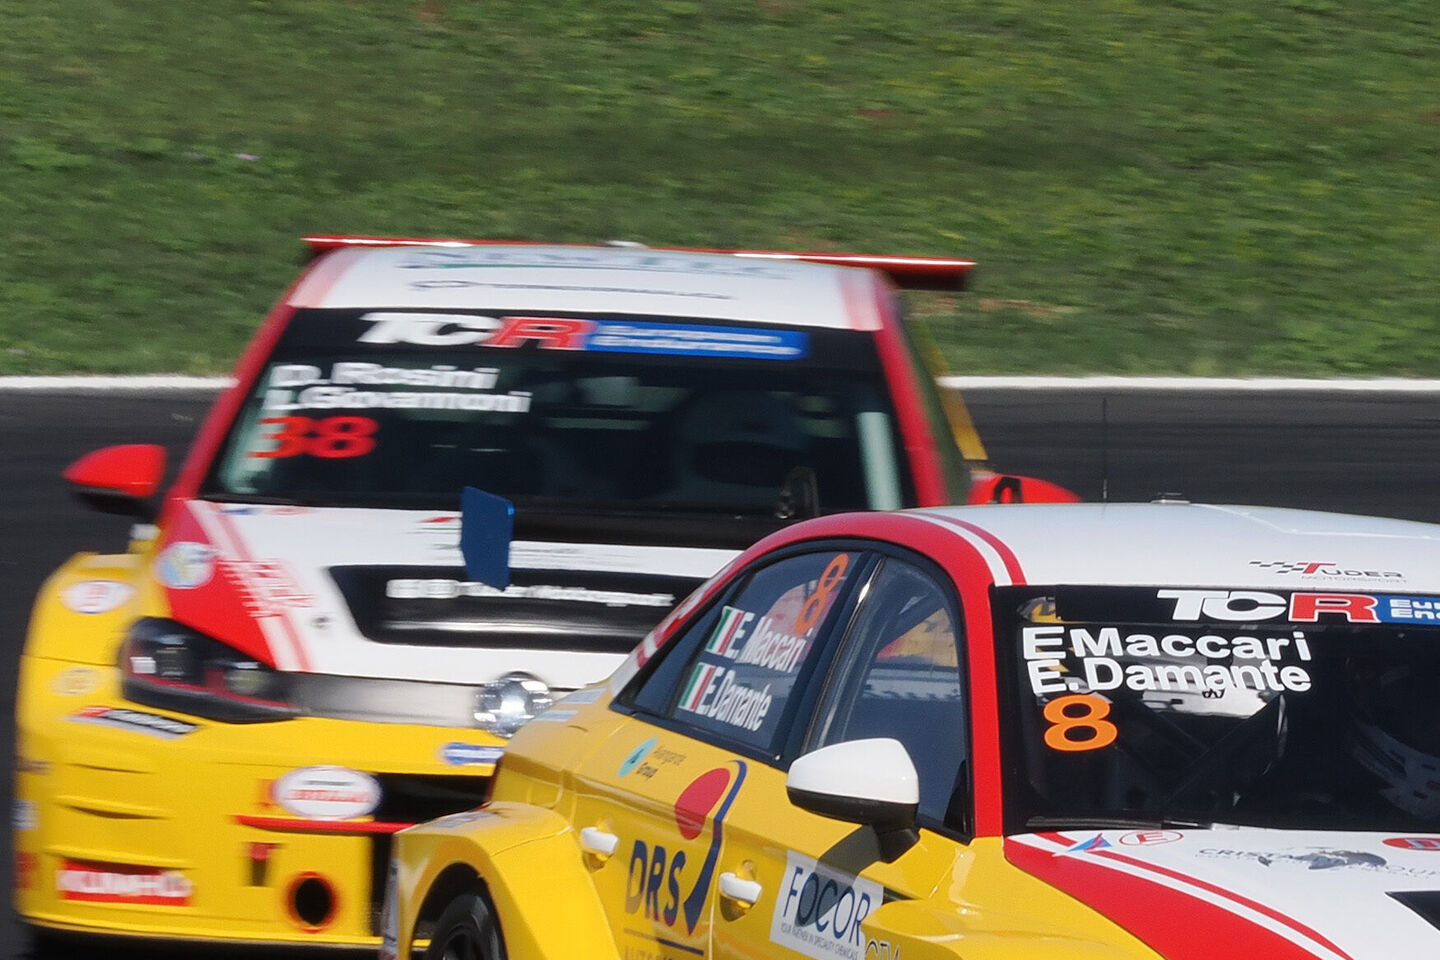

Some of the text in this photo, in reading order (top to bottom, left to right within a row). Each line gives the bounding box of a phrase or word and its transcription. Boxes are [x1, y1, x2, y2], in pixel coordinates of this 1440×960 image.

[358, 312, 598, 351] TCR
[245, 416, 379, 458] 38
[794, 553, 849, 635] 8
[1156, 589, 1382, 624] TCR
[1027, 657, 1311, 697] E.Damante
[1043, 694, 1118, 751] 8
[624, 839, 686, 927] DRS
[783, 866, 870, 947] FOCOR
